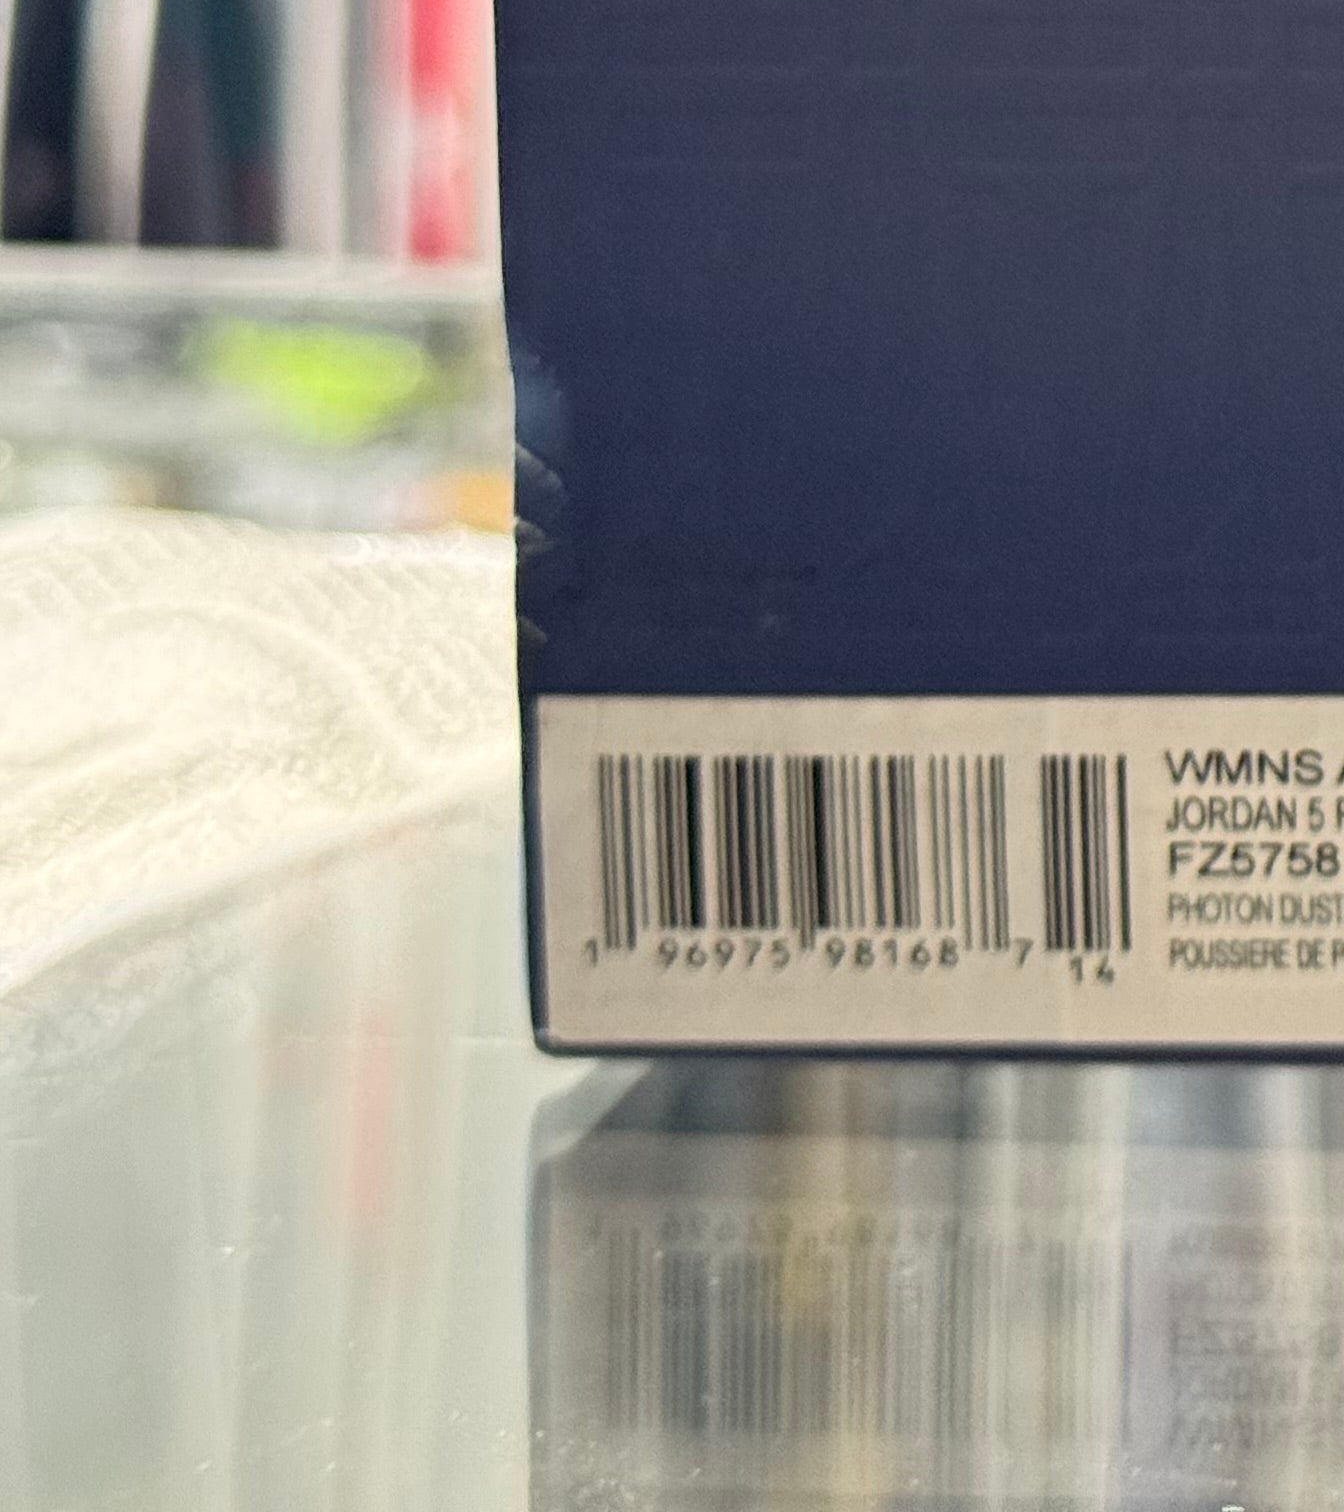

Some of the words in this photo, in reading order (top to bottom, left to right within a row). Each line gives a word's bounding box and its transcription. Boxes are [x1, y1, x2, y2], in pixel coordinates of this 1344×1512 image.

[1165, 748, 1324, 785] WMNS
[1166, 796, 1297, 832] JORDAN
[1307, 796, 1326, 832] 5
[1168, 841, 1340, 877] FZ5758
[1168, 891, 1273, 924] PHOTON
[584, 937, 600, 969] 1
[658, 937, 791, 970] 96975
[825, 937, 960, 970] 98168
[1014, 937, 1033, 967] 7
[1169, 938, 1291, 970] POUSSIERE
[1297, 938, 1325, 970] DE
